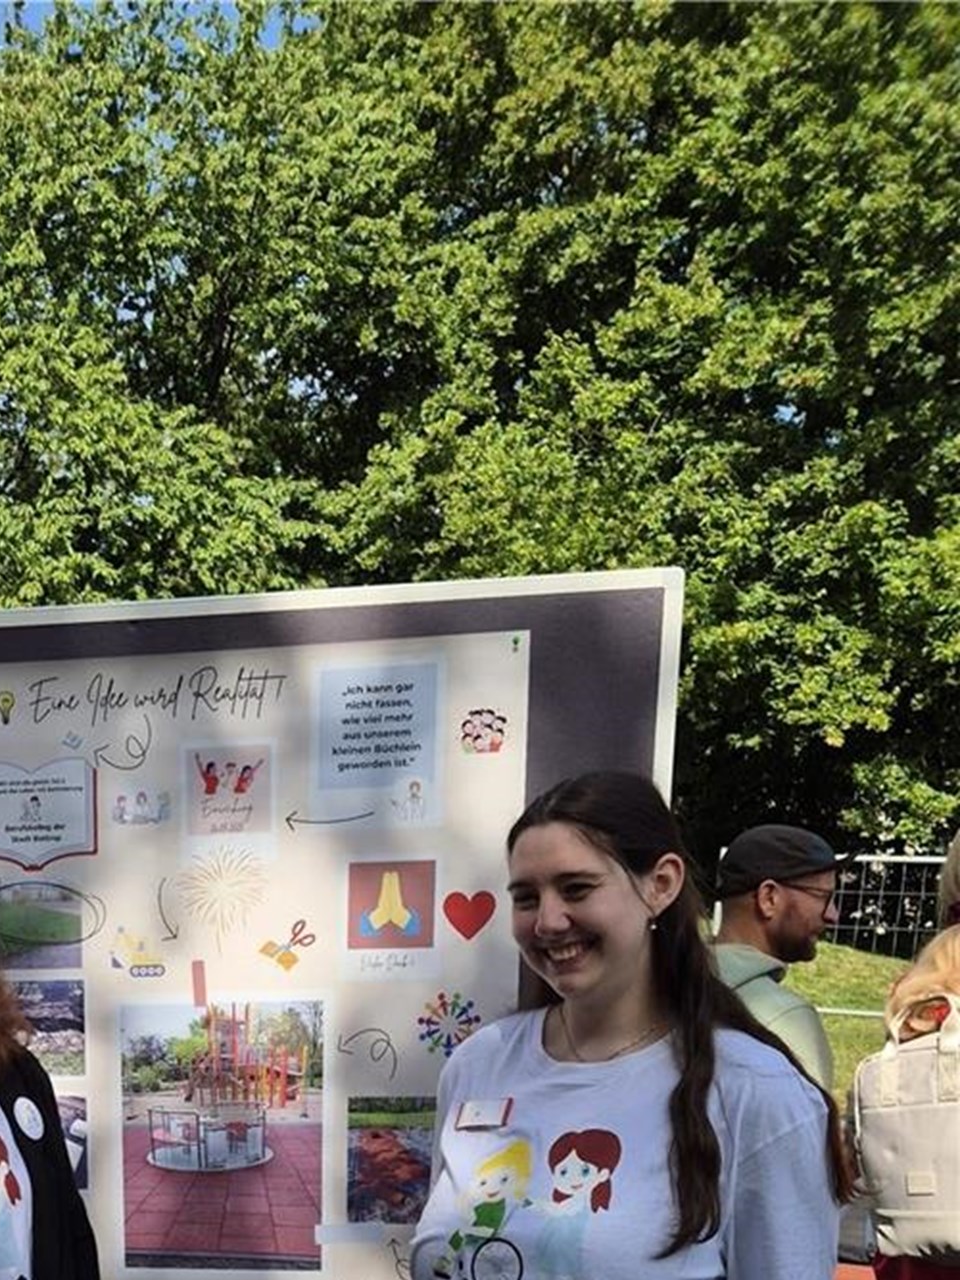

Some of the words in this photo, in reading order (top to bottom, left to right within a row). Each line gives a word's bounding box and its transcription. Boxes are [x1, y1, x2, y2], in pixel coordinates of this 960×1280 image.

[366, 684, 393, 695] kann
[395, 682, 415, 696] gar
[28, 676, 80, 724] Eine
[87, 673, 129, 727] Idee
[134, 674, 184, 718] wird
[345, 699, 373, 711] nicht
[341, 714, 361, 726] wie
[363, 712, 383, 725] viel
[384, 712, 414, 724] mehr
[341, 731, 361, 741] aus
[363, 729, 413, 740] unserem
[331, 745, 371, 756] kleinen
[374, 741, 422, 754] Büchlein
[337, 759, 392, 773] geworden
